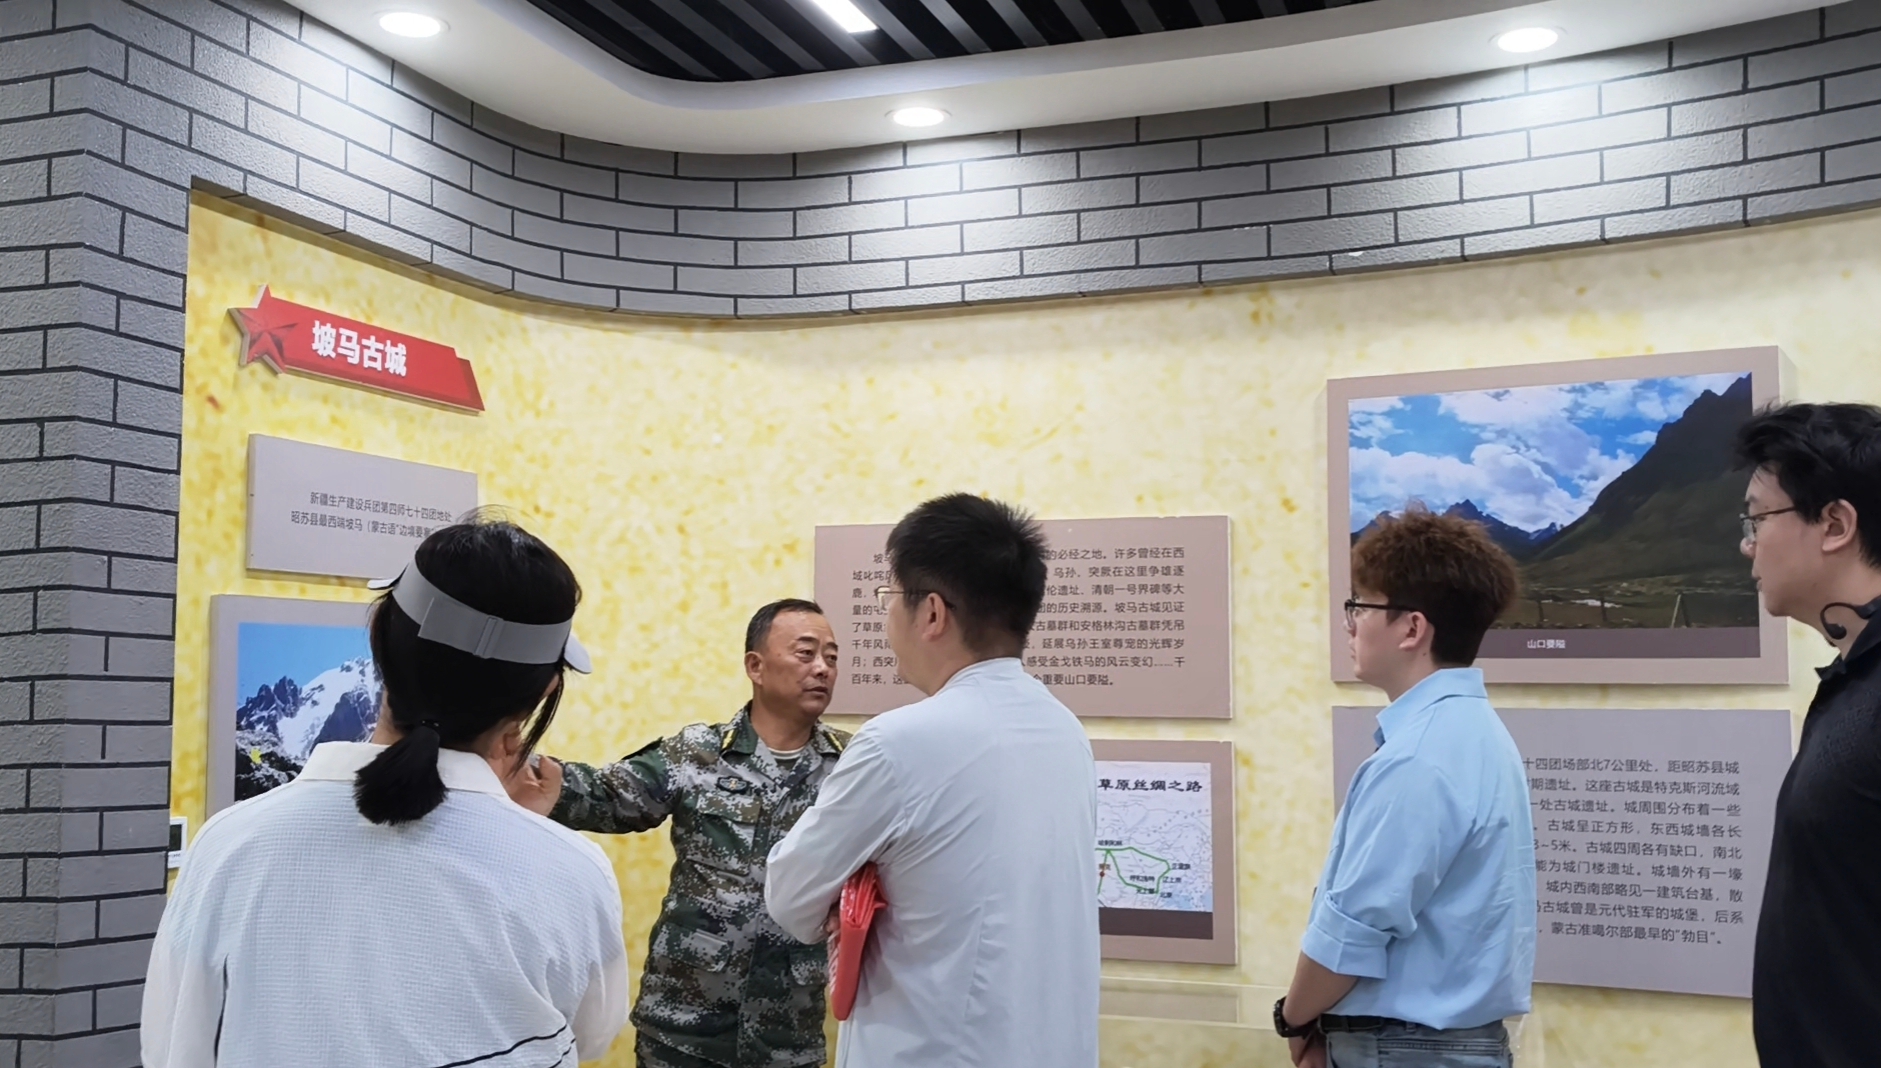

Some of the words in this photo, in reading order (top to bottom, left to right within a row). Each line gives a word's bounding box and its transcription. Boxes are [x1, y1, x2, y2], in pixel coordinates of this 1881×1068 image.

[311, 319, 407, 377] 坡马古城
[309, 491, 453, 523] 新疆生产建设兵团第四师七十四团地处
[852, 622, 887, 633] 了草原
[1029, 619, 1185, 632] 古墓群和安格林沟古墓群凭吊
[852, 656, 898, 667] 月；西突
[1021, 656, 1186, 668] 感受金戈铁马的风云变幻……千
[1097, 778, 1203, 792] 草原丝绸之路
[1527, 778, 1741, 796] 期遗址。这座古城是特克斯河流域
